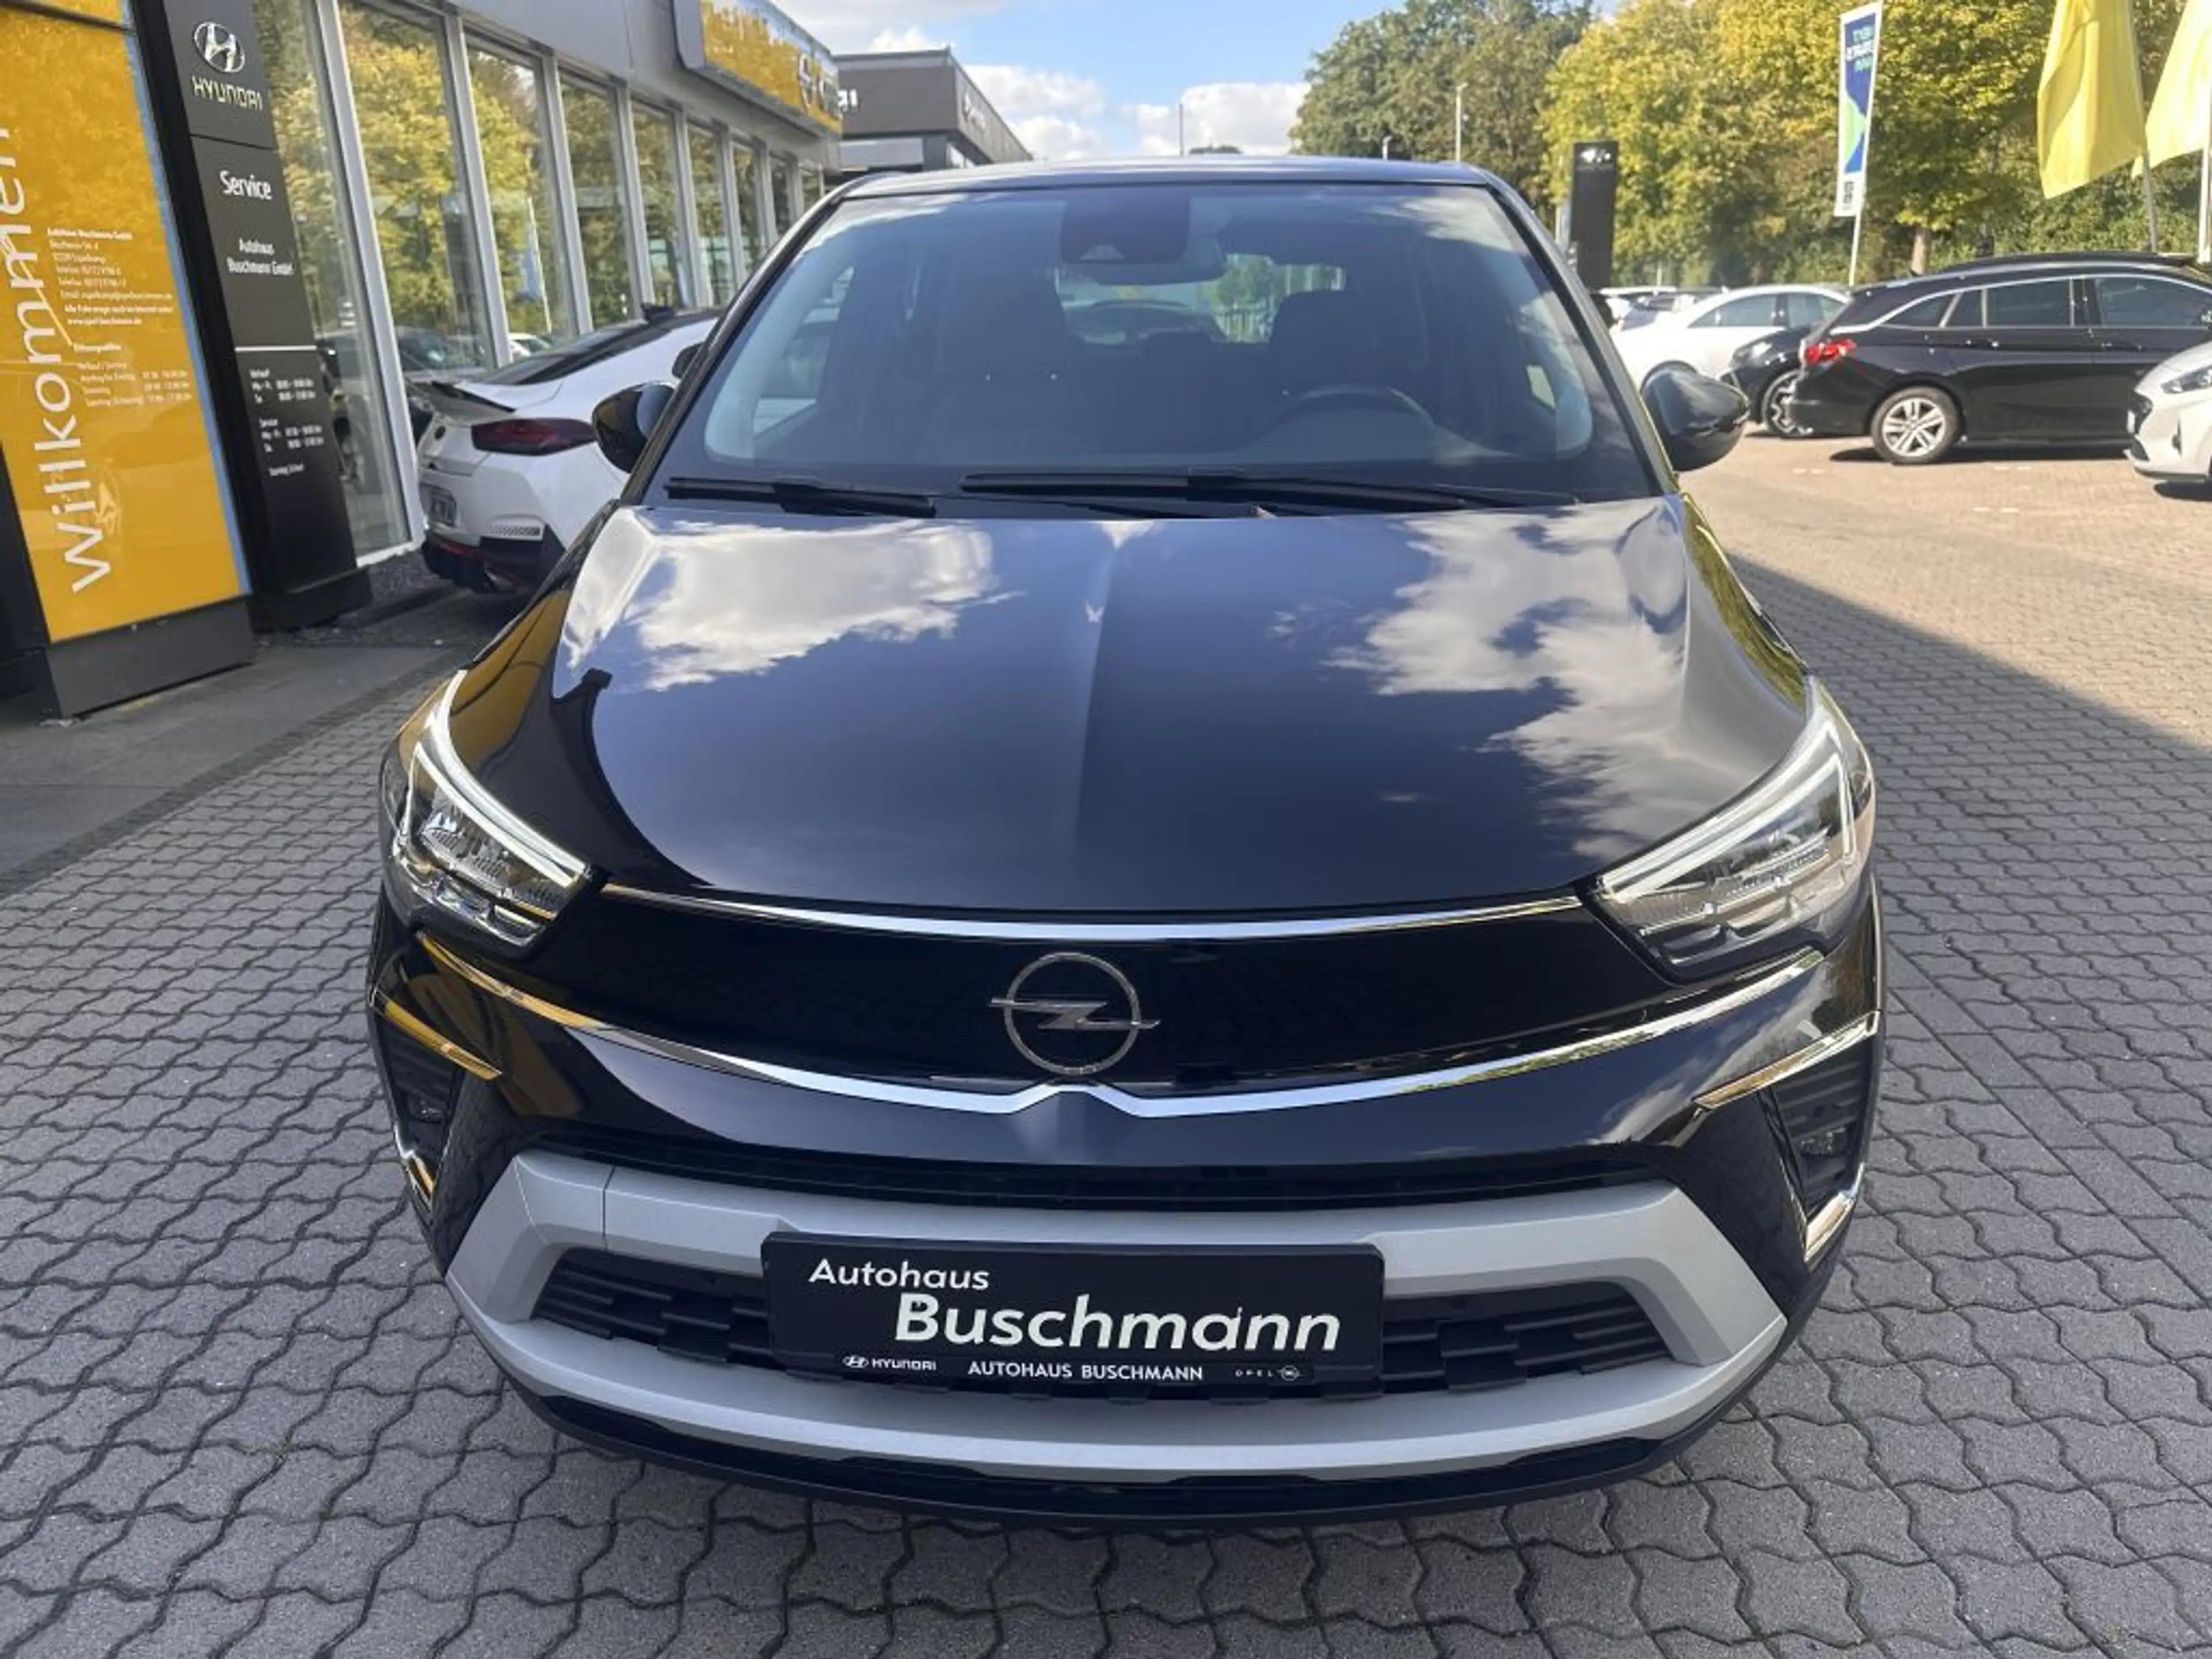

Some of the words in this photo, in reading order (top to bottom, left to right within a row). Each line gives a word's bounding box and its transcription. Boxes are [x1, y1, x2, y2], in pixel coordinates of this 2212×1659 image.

[191, 75, 263, 111] HYUNDAI
[219, 169, 273, 200] Service
[808, 1257, 990, 1290] Autohaus
[895, 1291, 1341, 1351] Buschmann
[872, 1358, 937, 1371] HYUNDAI
[967, 1361, 1073, 1378] AUTOHAUS
[1081, 1364, 1203, 1381] BUSCHMANN
